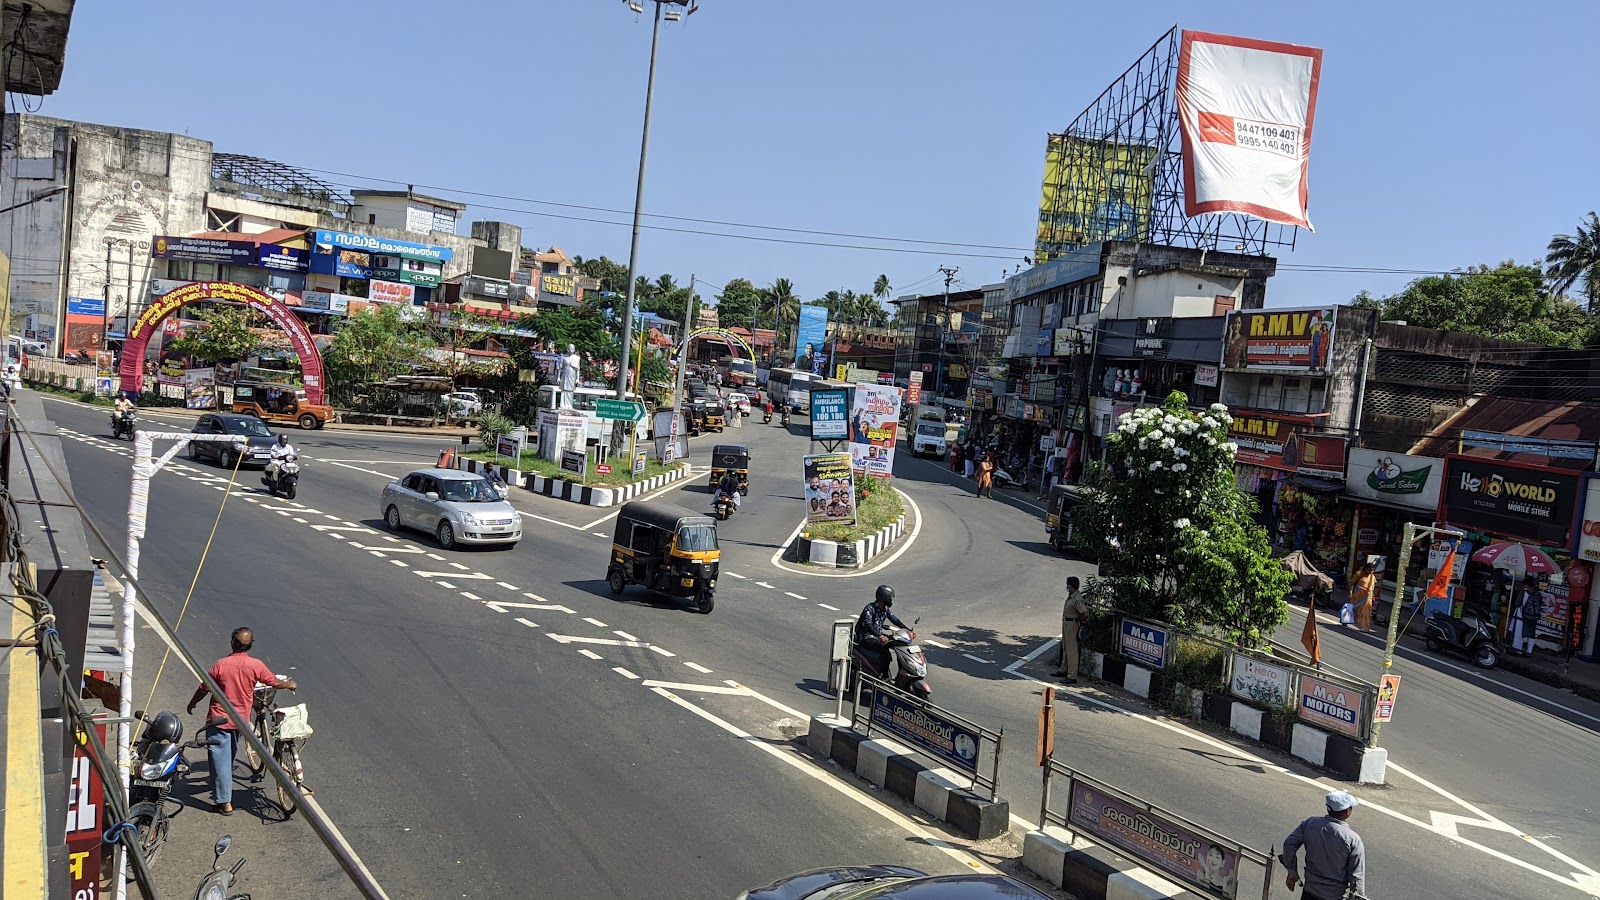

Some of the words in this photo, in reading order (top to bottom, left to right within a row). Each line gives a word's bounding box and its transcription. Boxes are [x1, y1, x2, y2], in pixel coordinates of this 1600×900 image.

[1279, 128, 1297, 141] 403
[1279, 142, 1296, 155] 403
[336, 233, 380, 249] സലാല
[372, 281, 411, 297] സലാല
[1250, 313, 1309, 337] R.M.V
[814, 398, 845, 406] AMBULANCE
[816, 412, 829, 421] 100
[831, 412, 844, 421] 100
[821, 405, 839, 414] 9188
[1504, 481, 1556, 503] WORLD
[1507, 503, 1530, 514] MOBILE
[1530, 507, 1550, 517] STORE
[1504, 556, 1519, 564] 4G
[1125, 637, 1159, 655] MOTORS
[1254, 665, 1277, 680] Hero
[1305, 697, 1352, 721] MOTORS
